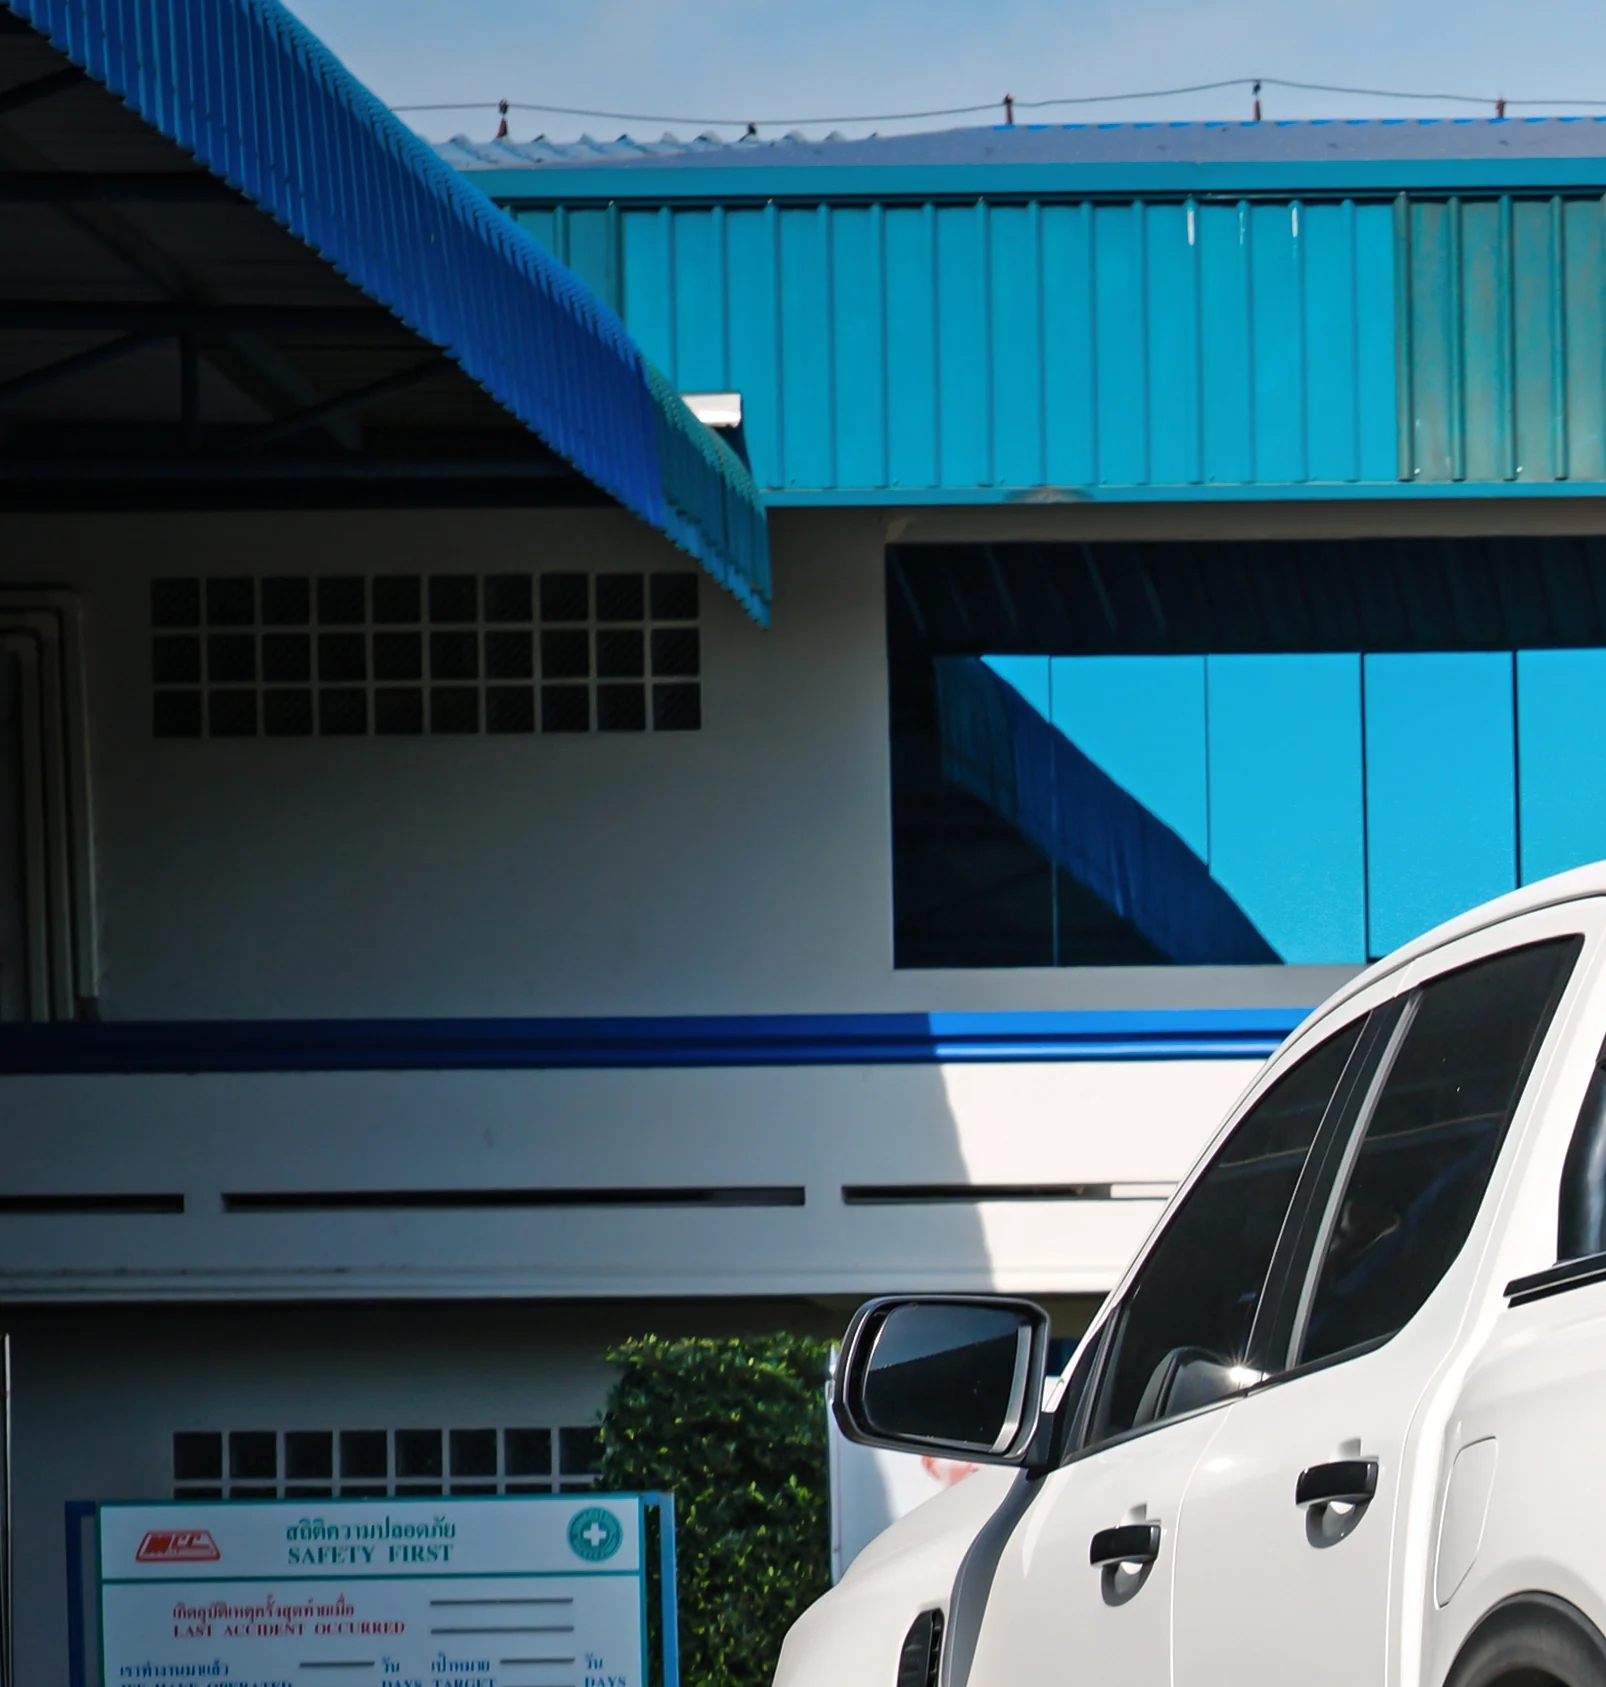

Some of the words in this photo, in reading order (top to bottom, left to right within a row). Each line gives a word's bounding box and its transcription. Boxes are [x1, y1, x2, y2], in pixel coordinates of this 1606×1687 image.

[288, 1545, 375, 1565] SAFETY
[388, 1543, 454, 1563] FIRST
[173, 1622, 213, 1638] LAST
[224, 1621, 305, 1638] ACCIDENT
[314, 1620, 405, 1636] OCCURRED
